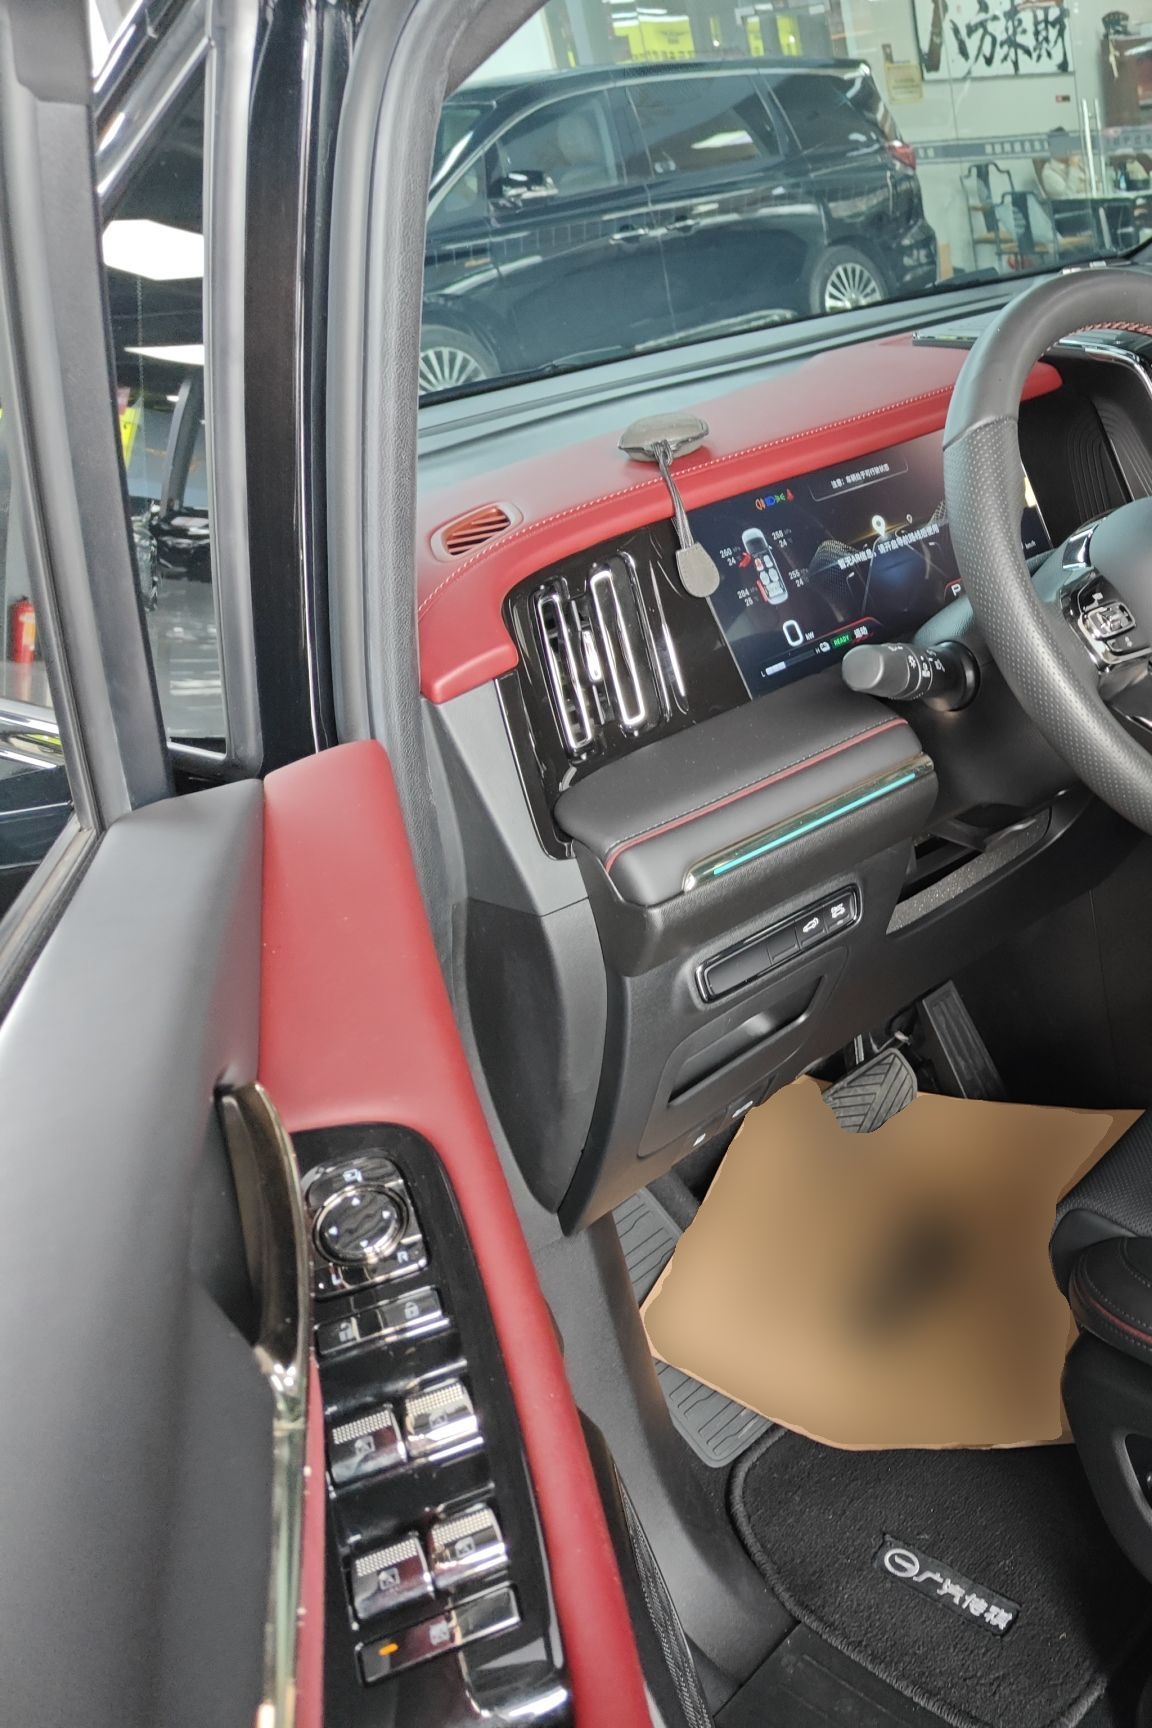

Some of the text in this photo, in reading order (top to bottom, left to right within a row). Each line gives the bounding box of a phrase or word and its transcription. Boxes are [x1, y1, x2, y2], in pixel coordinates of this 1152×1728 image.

[951, 583, 961, 597] P
[783, 620, 804, 647] 0
[833, 635, 850, 647] READY
[396, 1251, 409, 1264] R
[913, 1571, 1013, 1630] 广汽传祺
